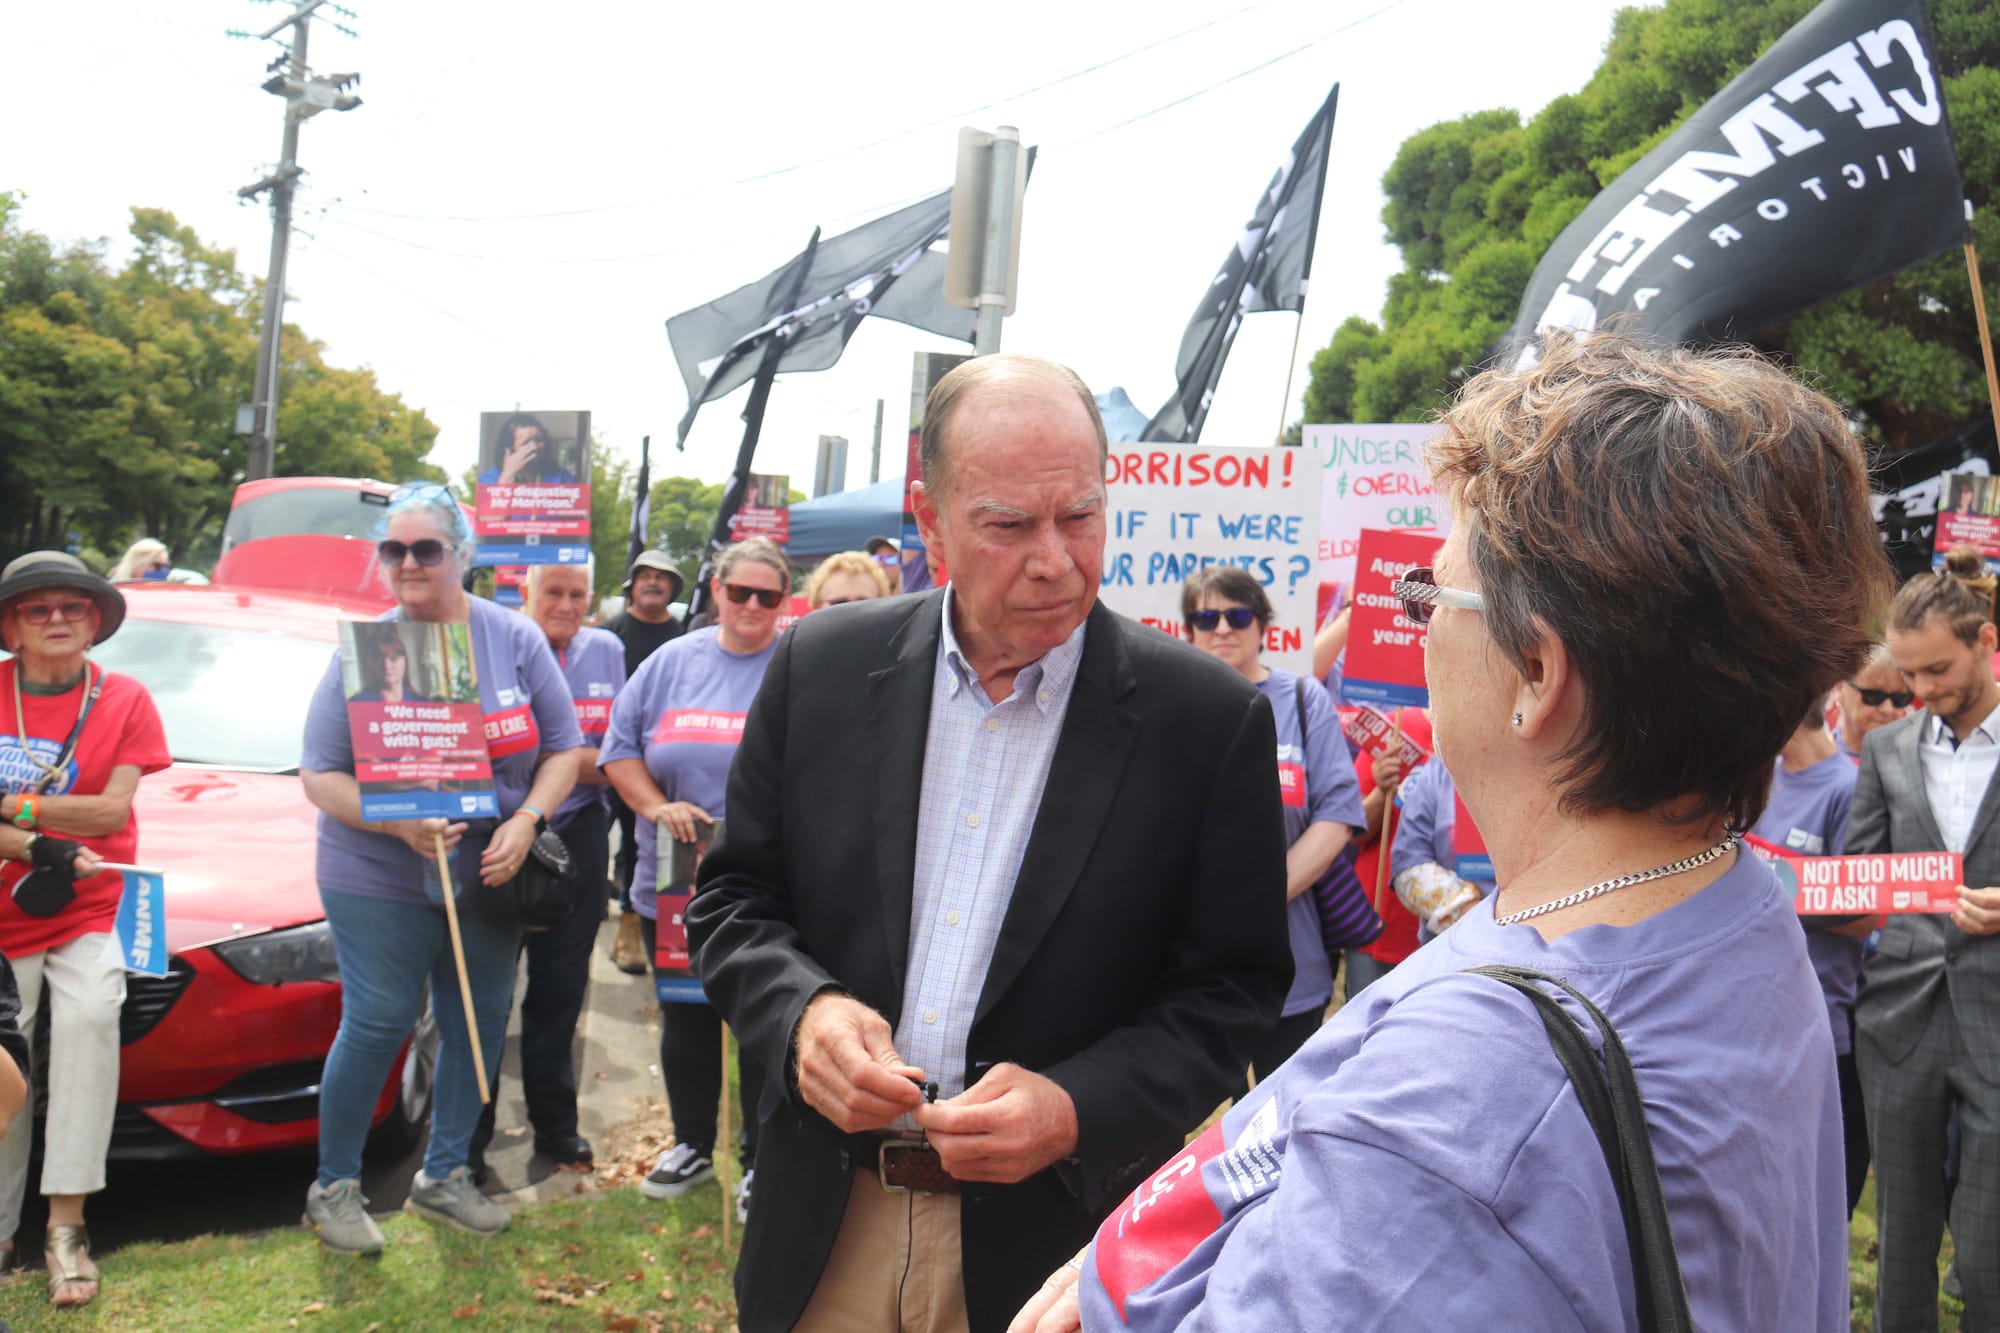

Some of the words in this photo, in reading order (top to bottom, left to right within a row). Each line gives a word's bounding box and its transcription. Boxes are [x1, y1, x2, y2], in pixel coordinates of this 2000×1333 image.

[1387, 506, 1437, 526] OUR
[1116, 511, 1147, 539] IF
[1170, 513, 1201, 539] IT
[1217, 513, 1303, 544] WERE
[1373, 629, 1415, 646] year
[416, 706, 450, 719] need
[369, 722, 380, 733] a
[381, 721, 469, 735] government
[500, 714, 529, 736] CARE
[383, 733, 420, 748] with
[1802, 860, 1842, 885] NOT
[1844, 858, 1885, 883] TOO
[1890, 855, 1955, 882] MUCH
[1802, 887, 1827, 911] TO
[1831, 885, 1878, 910] ASK!
[130, 876, 153, 969] ANMF
